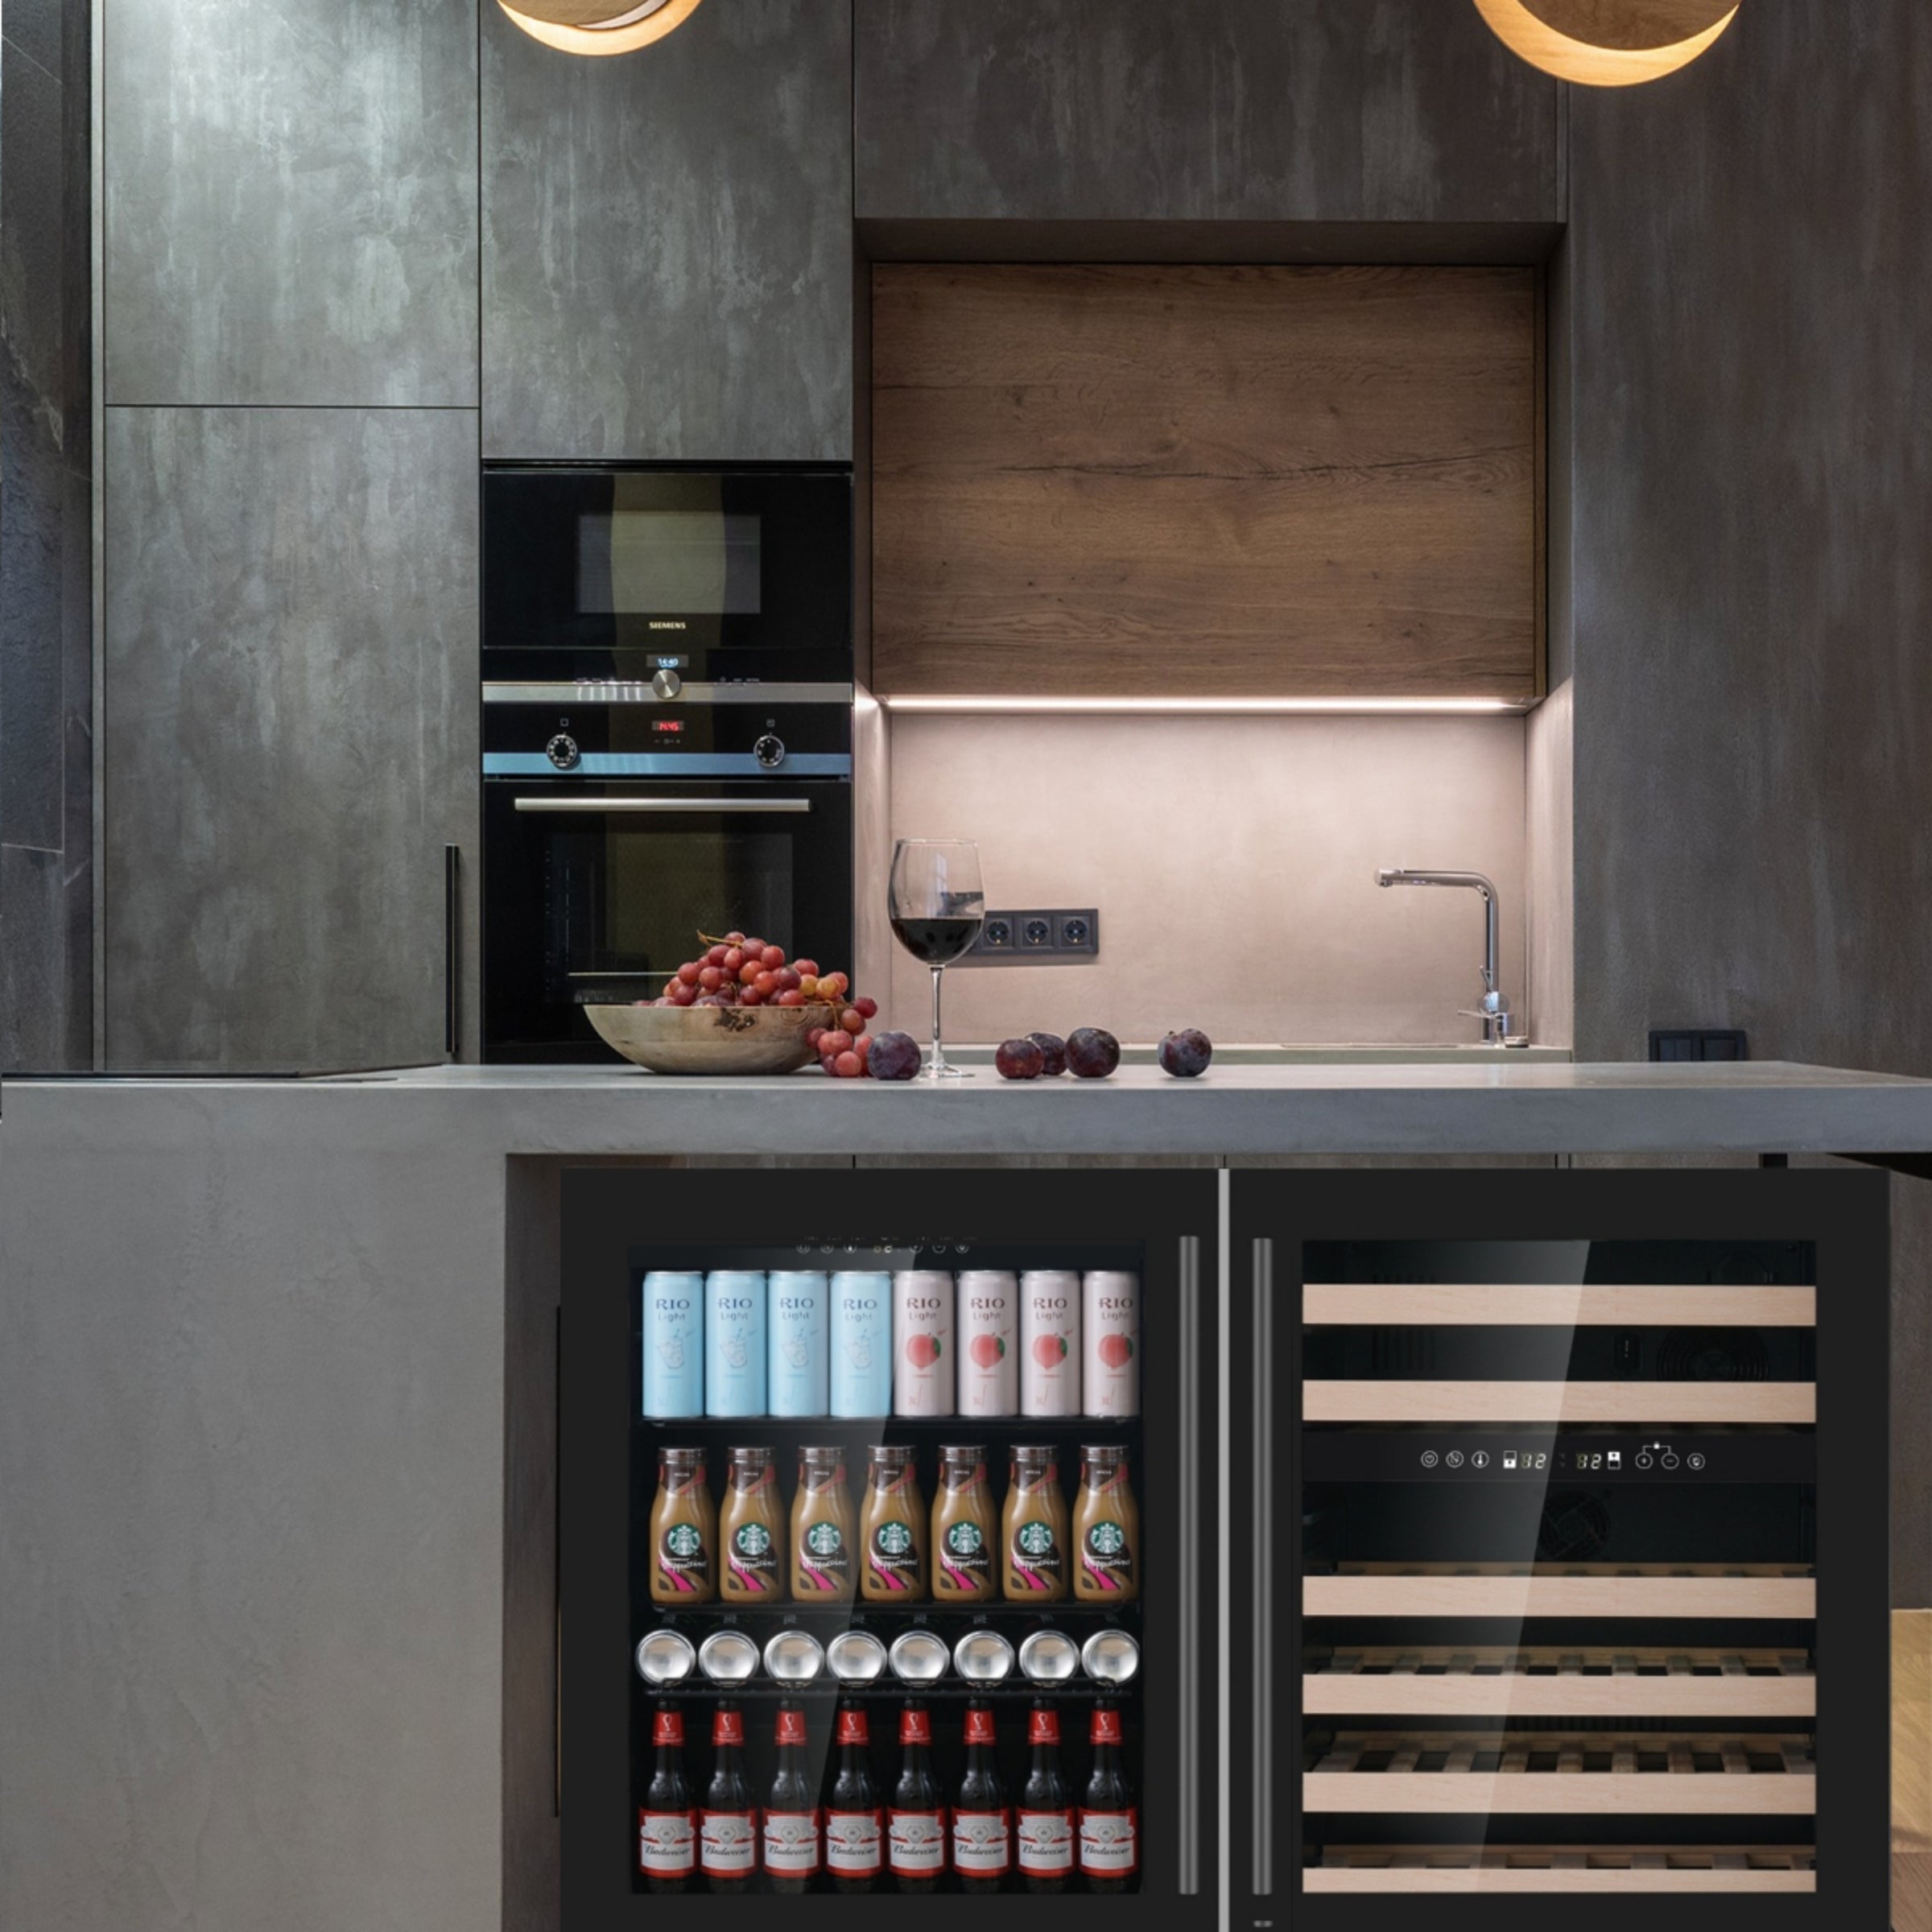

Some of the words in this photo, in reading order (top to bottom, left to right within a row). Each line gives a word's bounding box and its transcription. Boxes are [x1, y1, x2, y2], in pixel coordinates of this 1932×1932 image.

[649, 621, 686, 630] SIEMENS
[656, 1298, 690, 1310] RIO
[717, 1298, 753, 1309] RIO
[780, 1298, 814, 1309] RIO
[843, 1298, 877, 1310] RIO
[906, 1298, 941, 1309] RIO
[971, 1298, 1005, 1309] RIO
[1033, 1298, 1067, 1309] RIO
[1099, 1298, 1133, 1309] RIO
[658, 1312, 685, 1322] Light
[720, 1311, 749, 1321] Light
[782, 1311, 810, 1321] Light
[845, 1312, 873, 1322] Light
[909, 1311, 936, 1321] Light
[973, 1311, 1001, 1321] Light
[1035, 1311, 1063, 1321] Light
[1101, 1311, 1129, 1321] Light
